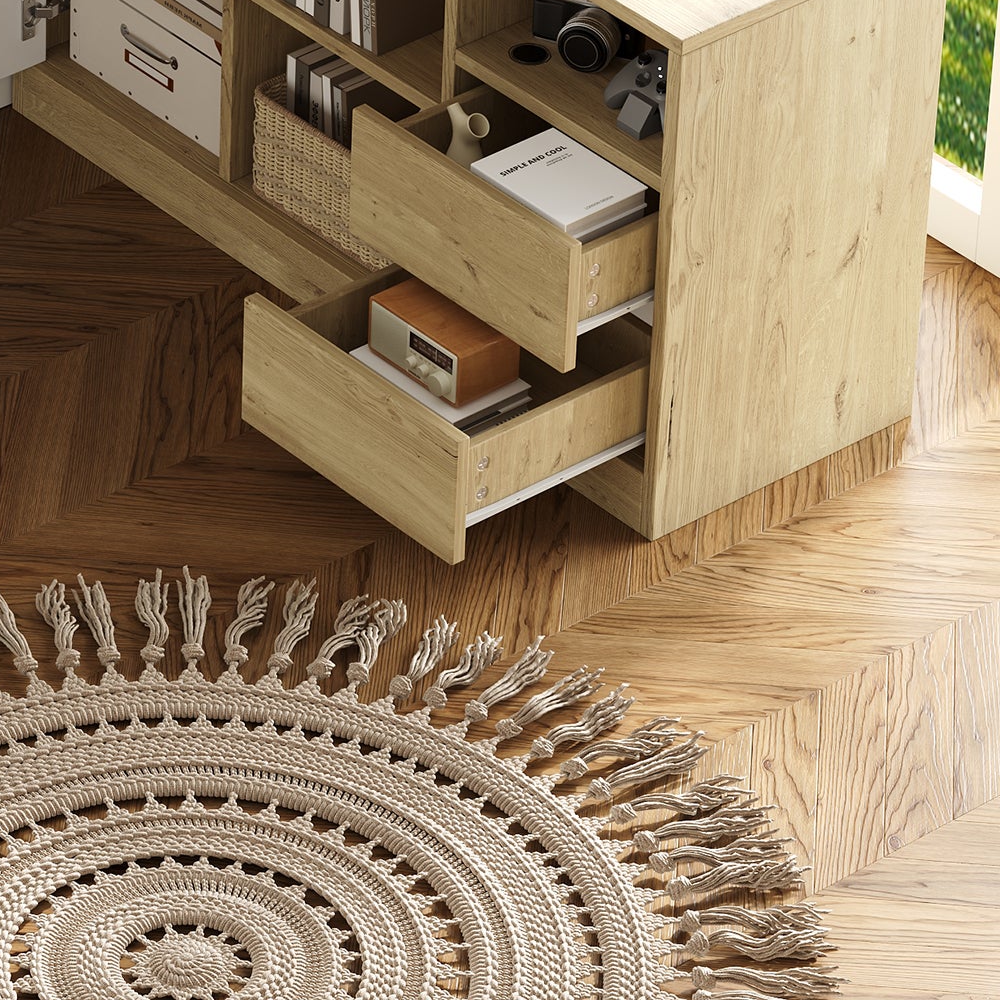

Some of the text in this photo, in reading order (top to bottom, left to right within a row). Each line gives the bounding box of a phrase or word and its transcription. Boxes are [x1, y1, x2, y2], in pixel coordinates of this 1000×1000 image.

[500, 162, 528, 177] SIMPLE
[527, 154, 545, 165] AND
[545, 145, 567, 157] COOL
